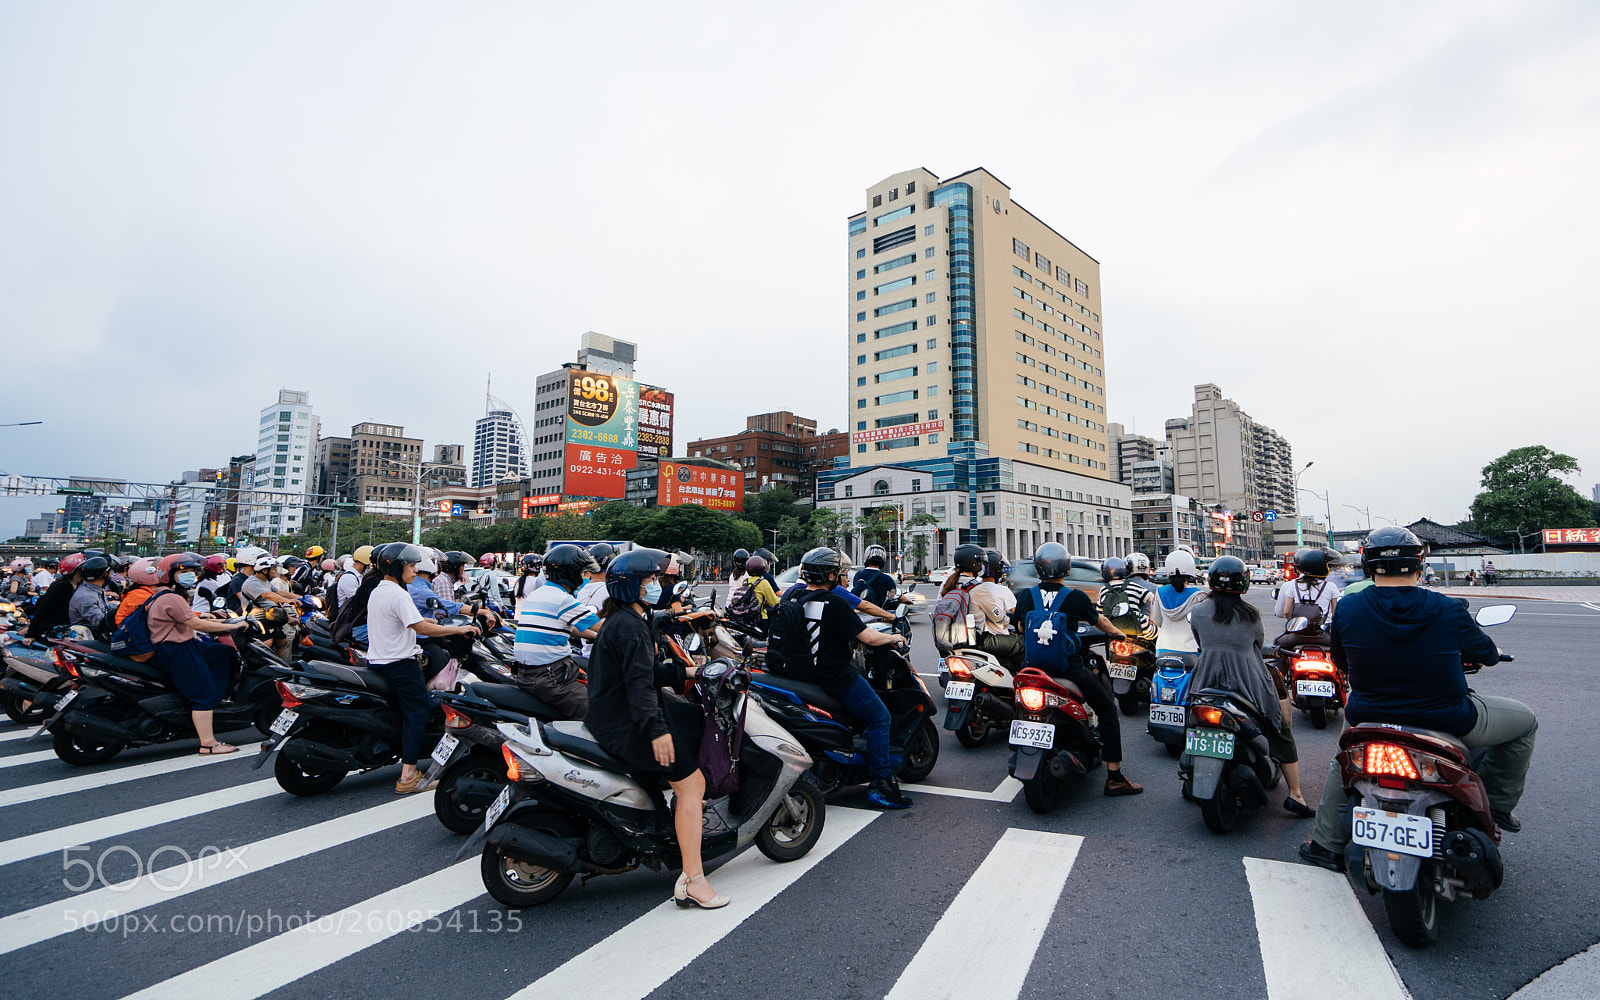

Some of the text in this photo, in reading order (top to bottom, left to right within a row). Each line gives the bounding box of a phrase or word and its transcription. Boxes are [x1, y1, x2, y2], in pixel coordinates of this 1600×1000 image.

[582, 377, 609, 402] 98
[571, 428, 619, 444] 2382-6688
[578, 450, 624, 465] 廣告洽
[678, 485, 705, 495] 台北車站
